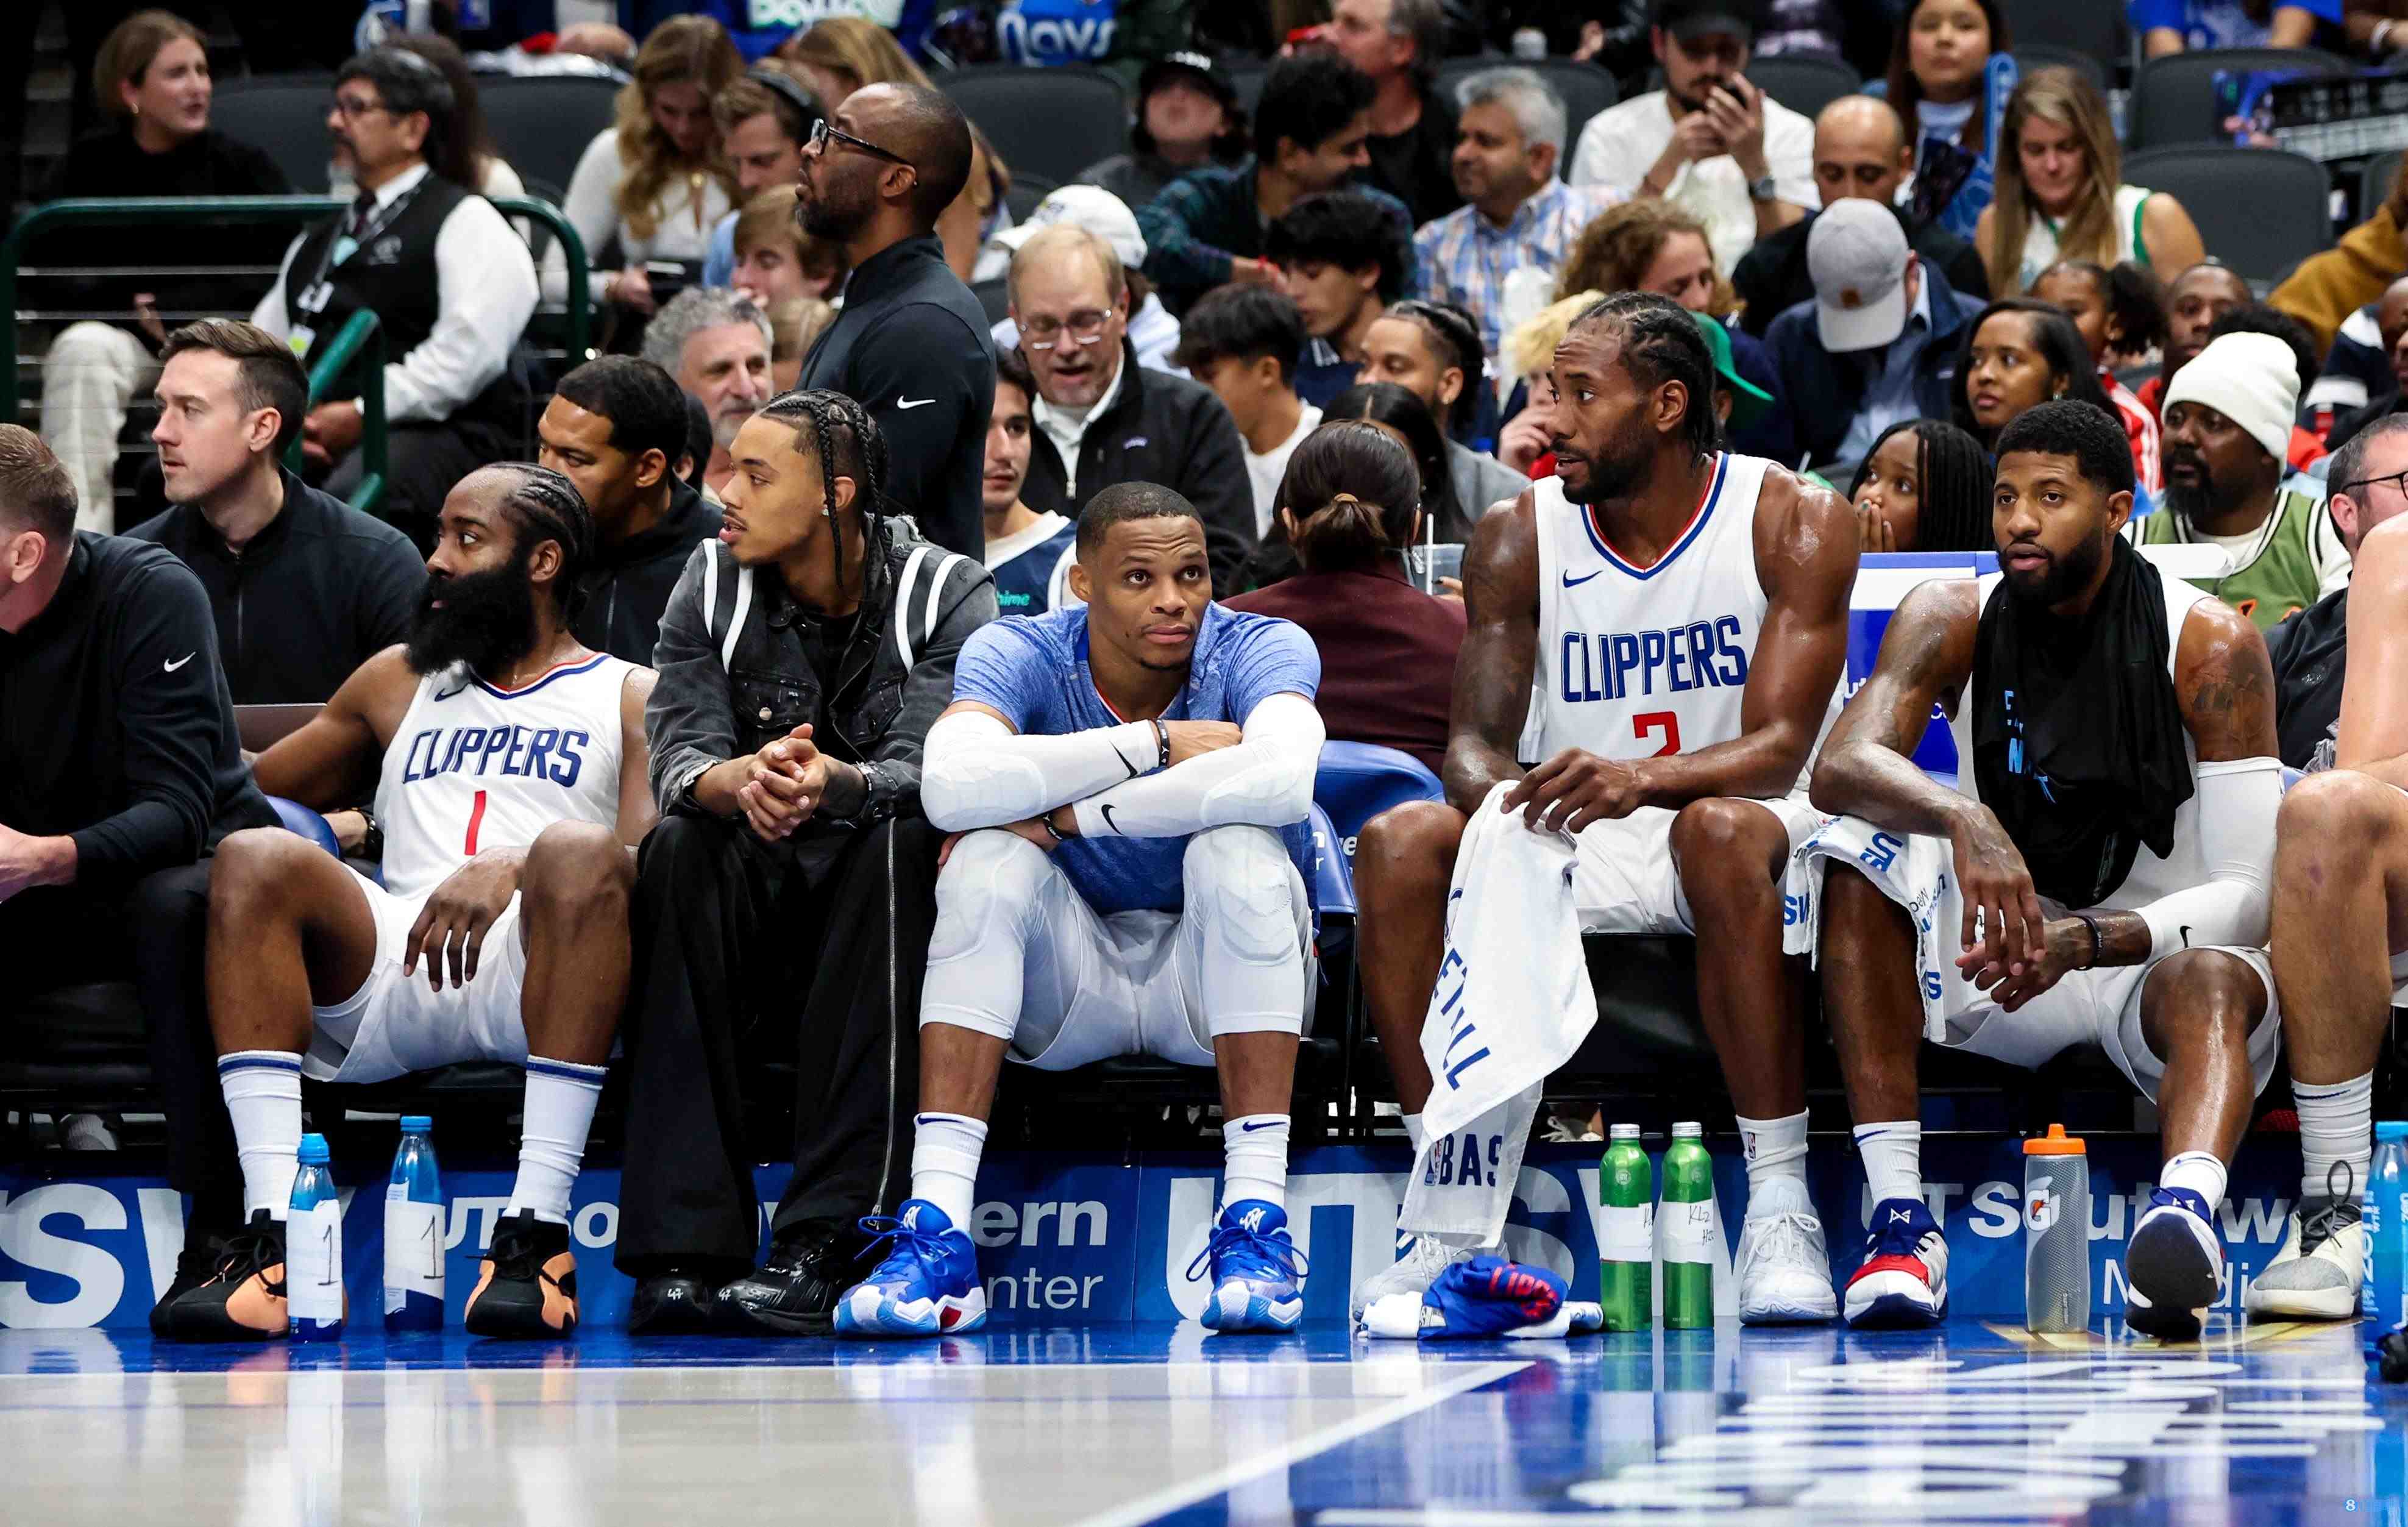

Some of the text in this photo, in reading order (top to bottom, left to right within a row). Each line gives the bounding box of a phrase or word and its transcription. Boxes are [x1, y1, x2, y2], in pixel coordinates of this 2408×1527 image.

[1561, 614, 1749, 702] CLIPPERS
[403, 722, 589, 788] CLIPPERS
[465, 790, 486, 856] 1
[318, 1224, 341, 1286] 1
[421, 1214, 444, 1279] 1
